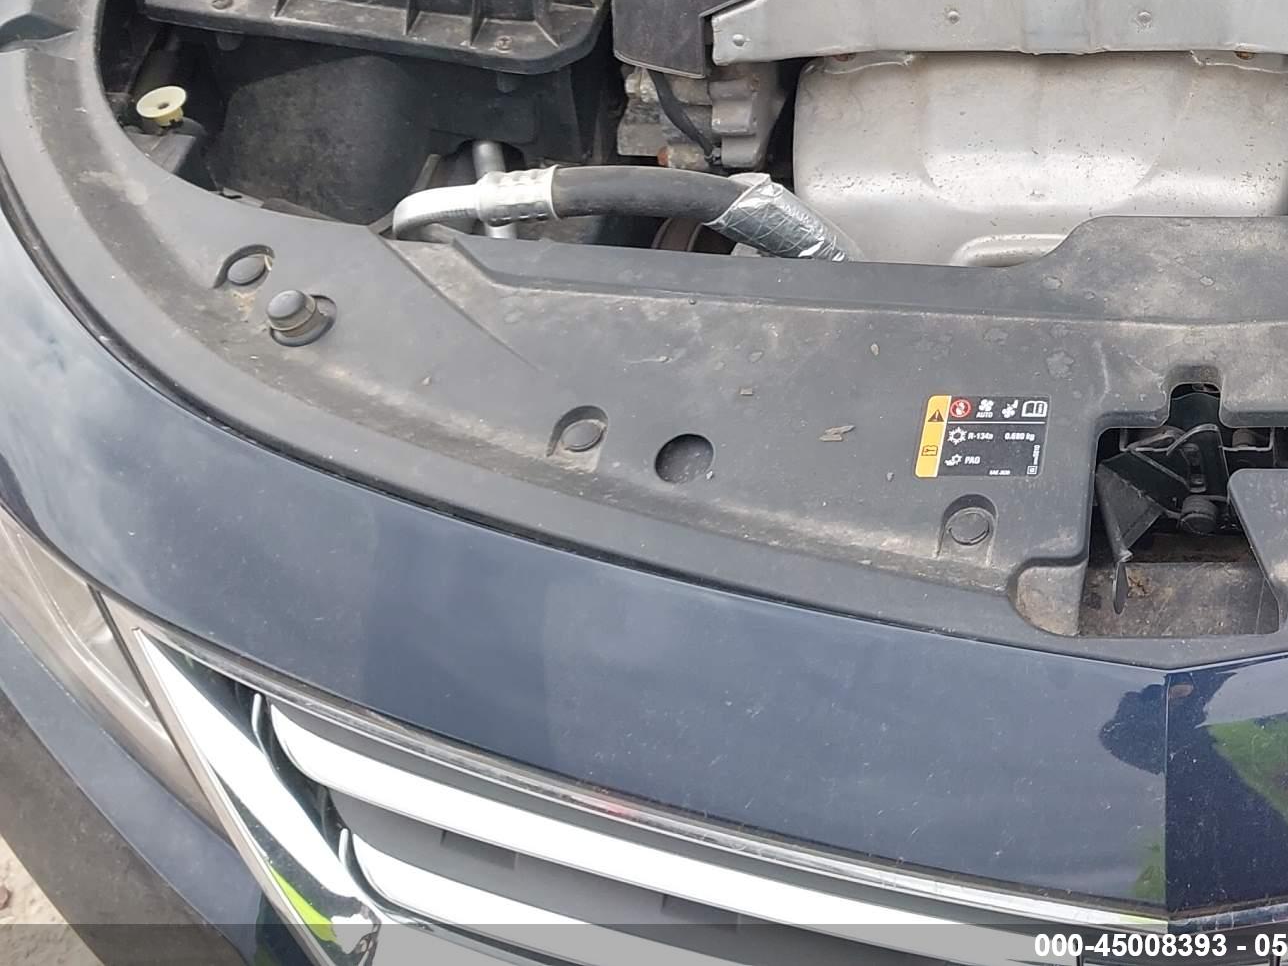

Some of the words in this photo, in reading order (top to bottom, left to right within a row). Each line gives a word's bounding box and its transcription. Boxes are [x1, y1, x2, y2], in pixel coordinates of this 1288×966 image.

[976, 411, 994, 419] AUTO
[967, 432, 994, 440] R-134a
[1025, 432, 1036, 442] kg
